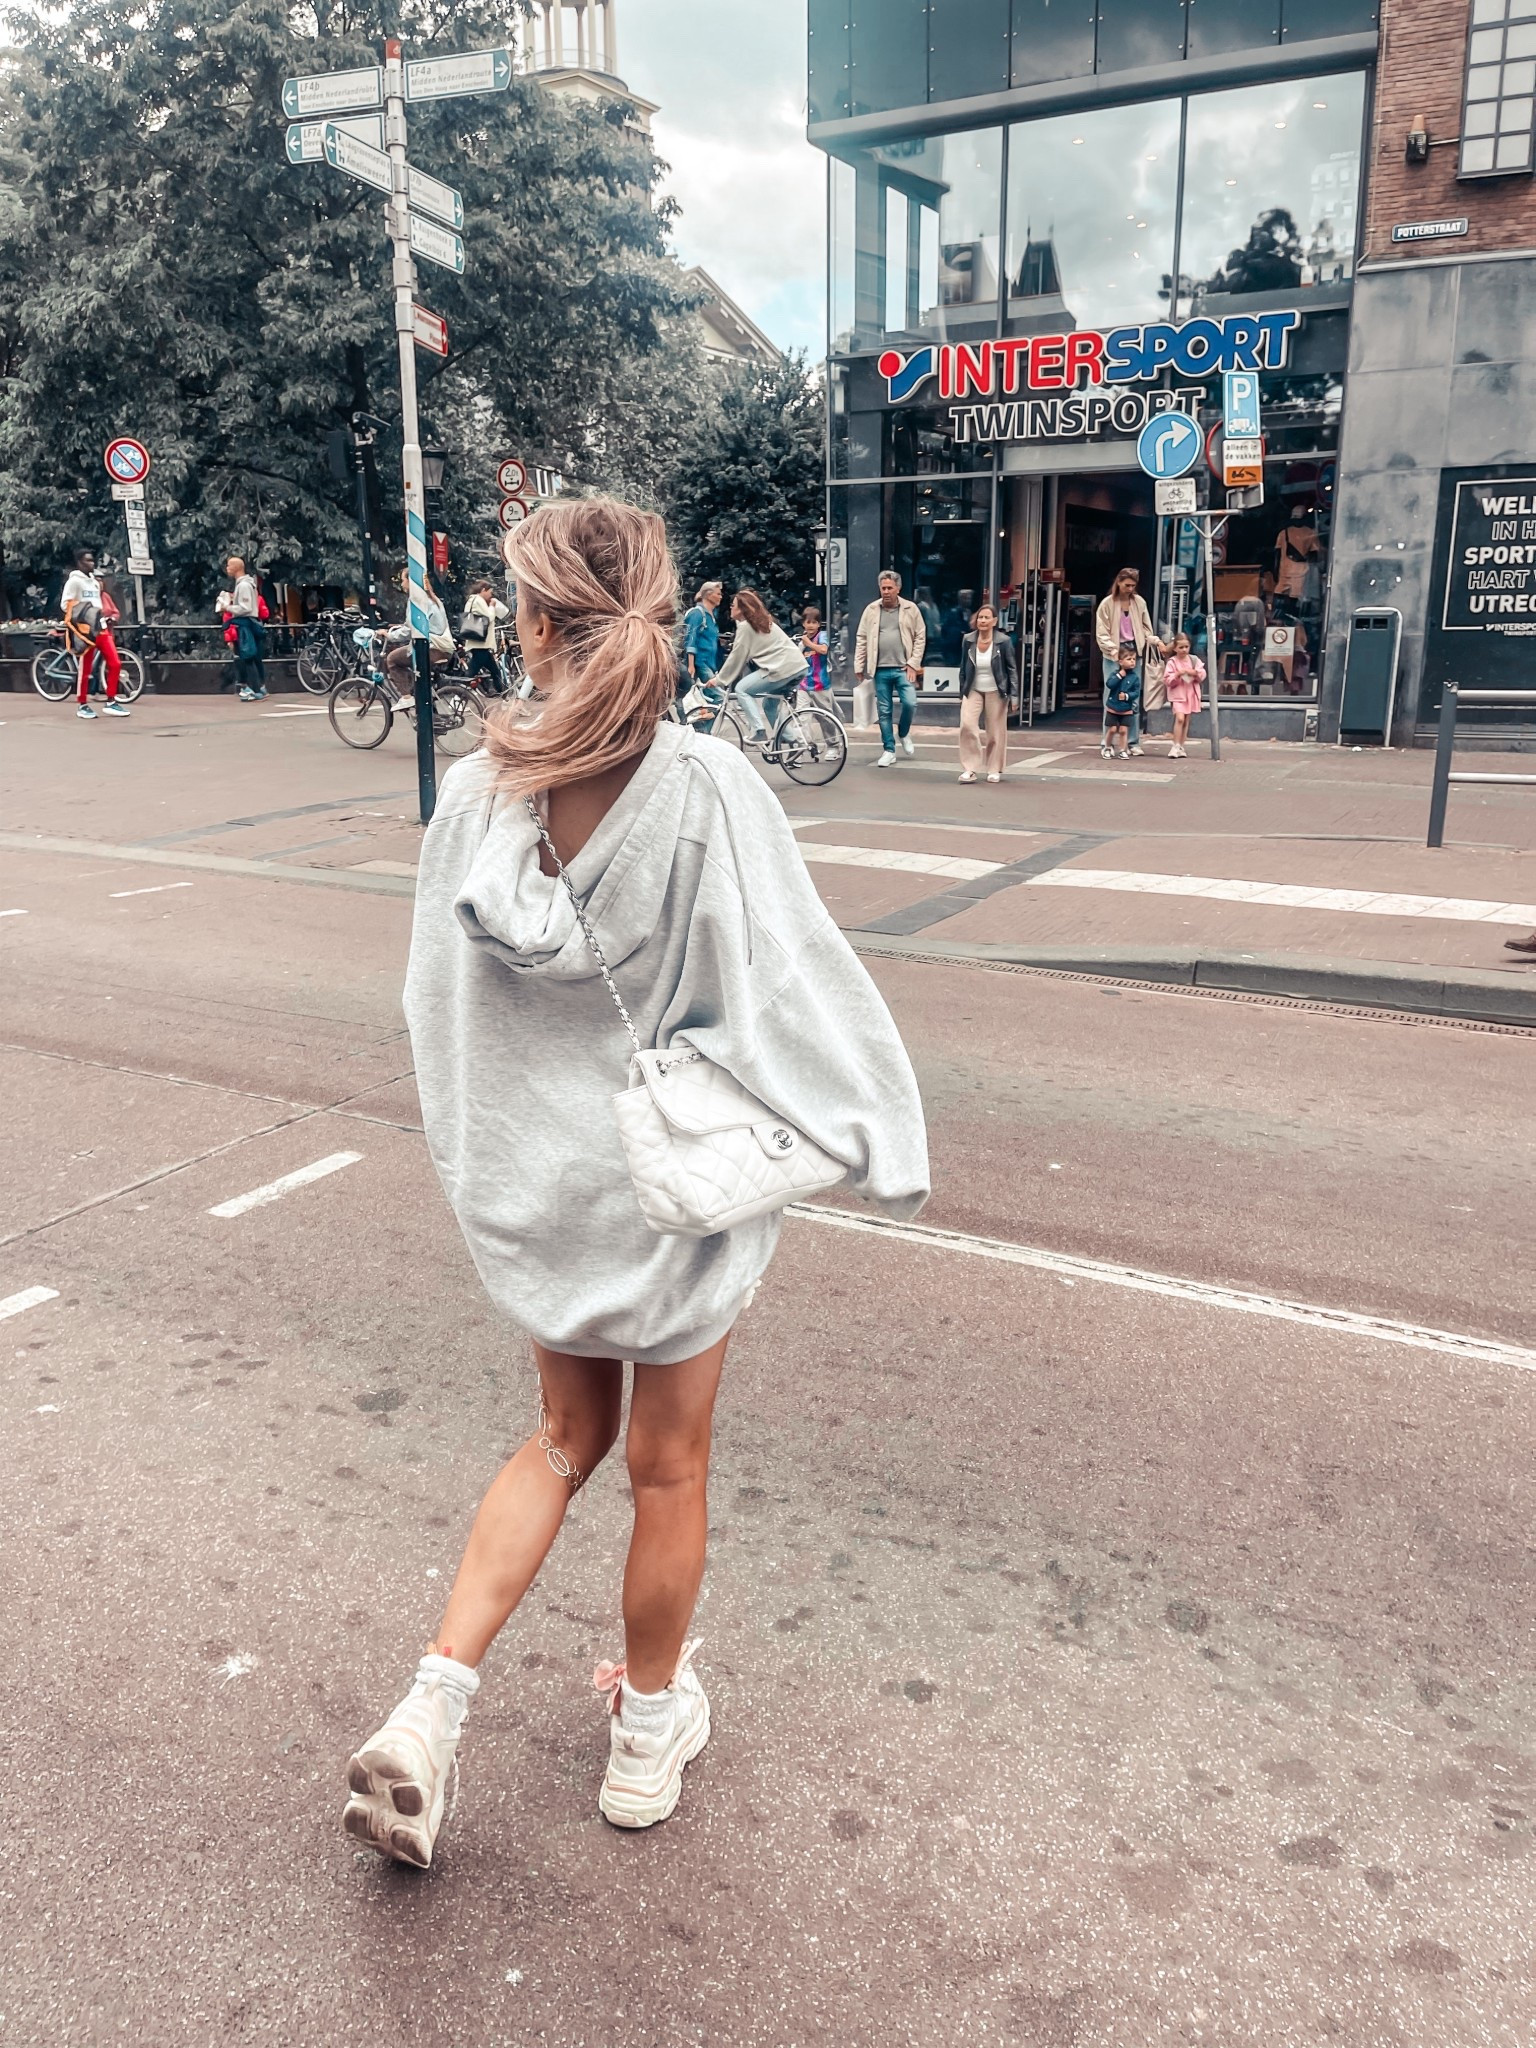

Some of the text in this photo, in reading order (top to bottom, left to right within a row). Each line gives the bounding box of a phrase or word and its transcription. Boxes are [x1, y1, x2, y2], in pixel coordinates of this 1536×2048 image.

[410, 66, 432, 77] LF4a
[300, 82, 320, 93] LF4b
[1397, 222, 1461, 238] POTTERSTRAAT
[938, 310, 1300, 398] INTERSPORT
[1232, 377, 1251, 411] P
[949, 387, 1207, 443] TWINSPORT
[1481, 496, 1536, 516] WEL
[1491, 520, 1518, 541] IN
[1463, 545, 1536, 566] SPORT
[1467, 570, 1530, 590] HART
